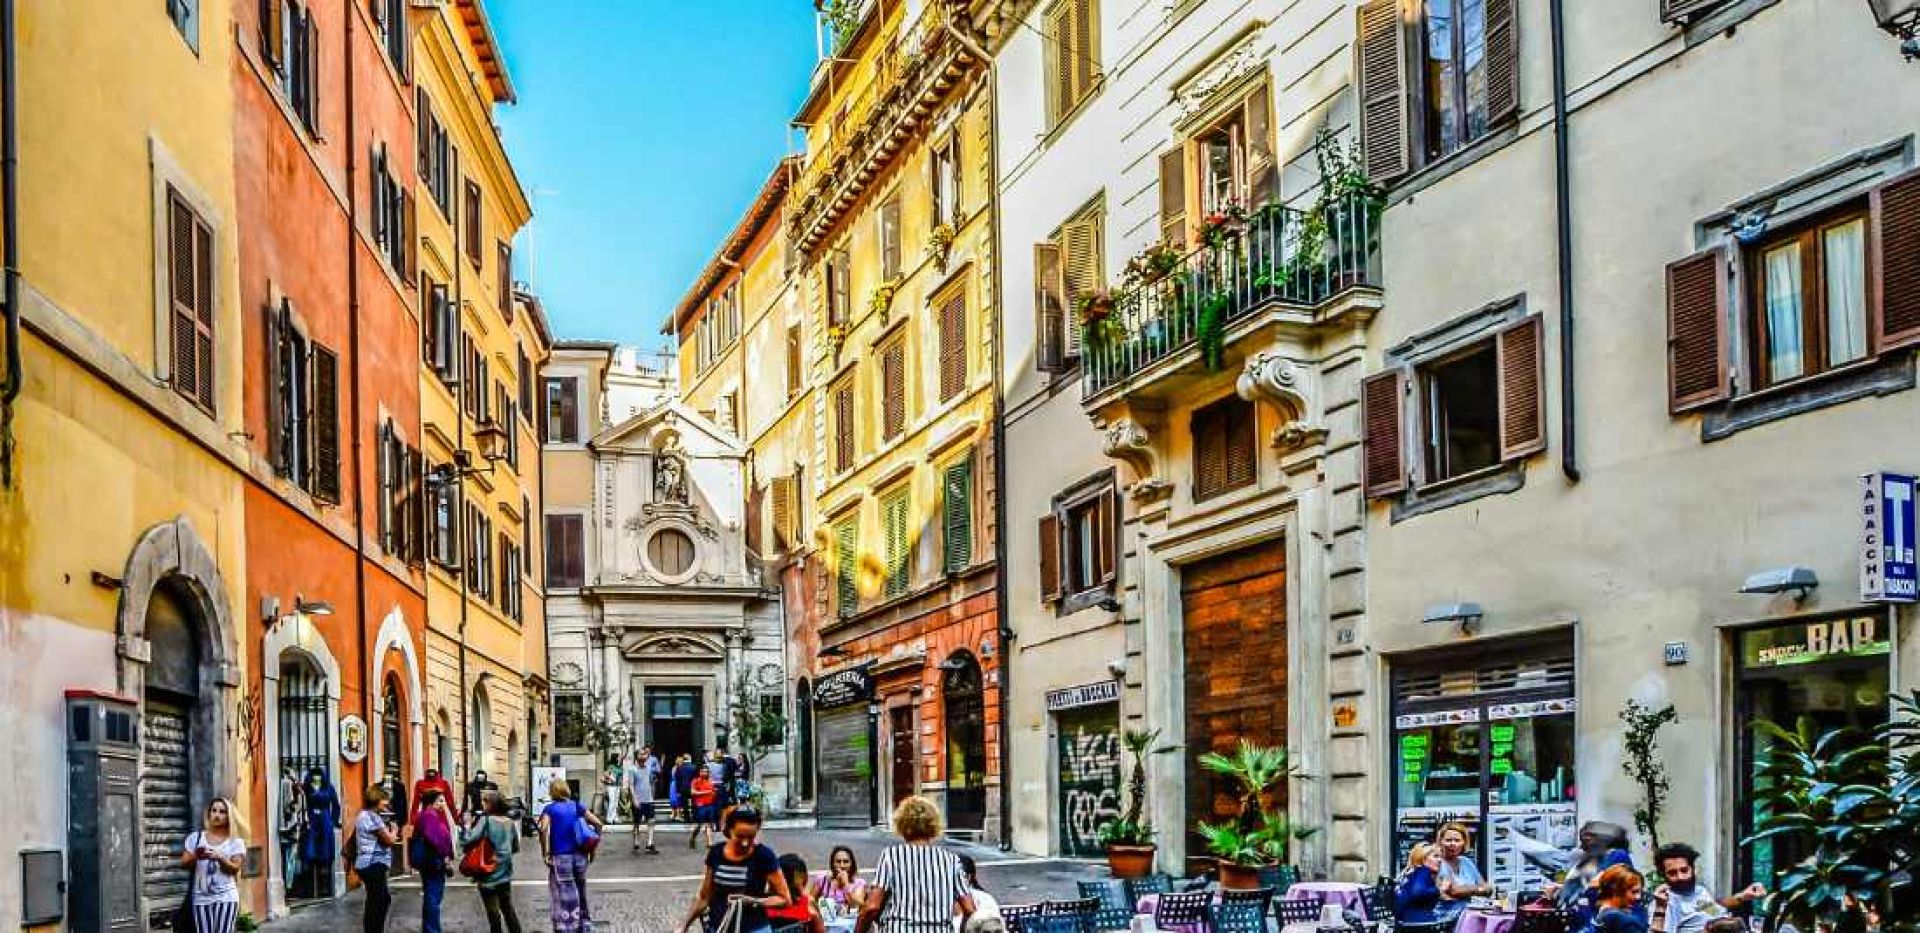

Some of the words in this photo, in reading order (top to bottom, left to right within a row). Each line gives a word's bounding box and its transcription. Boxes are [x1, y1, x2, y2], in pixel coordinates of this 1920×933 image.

[1861, 475, 1877, 590] TABACCHI
[1884, 481, 1911, 563] T
[1667, 645, 1685, 661] 90
[1807, 616, 1875, 655] BAR
